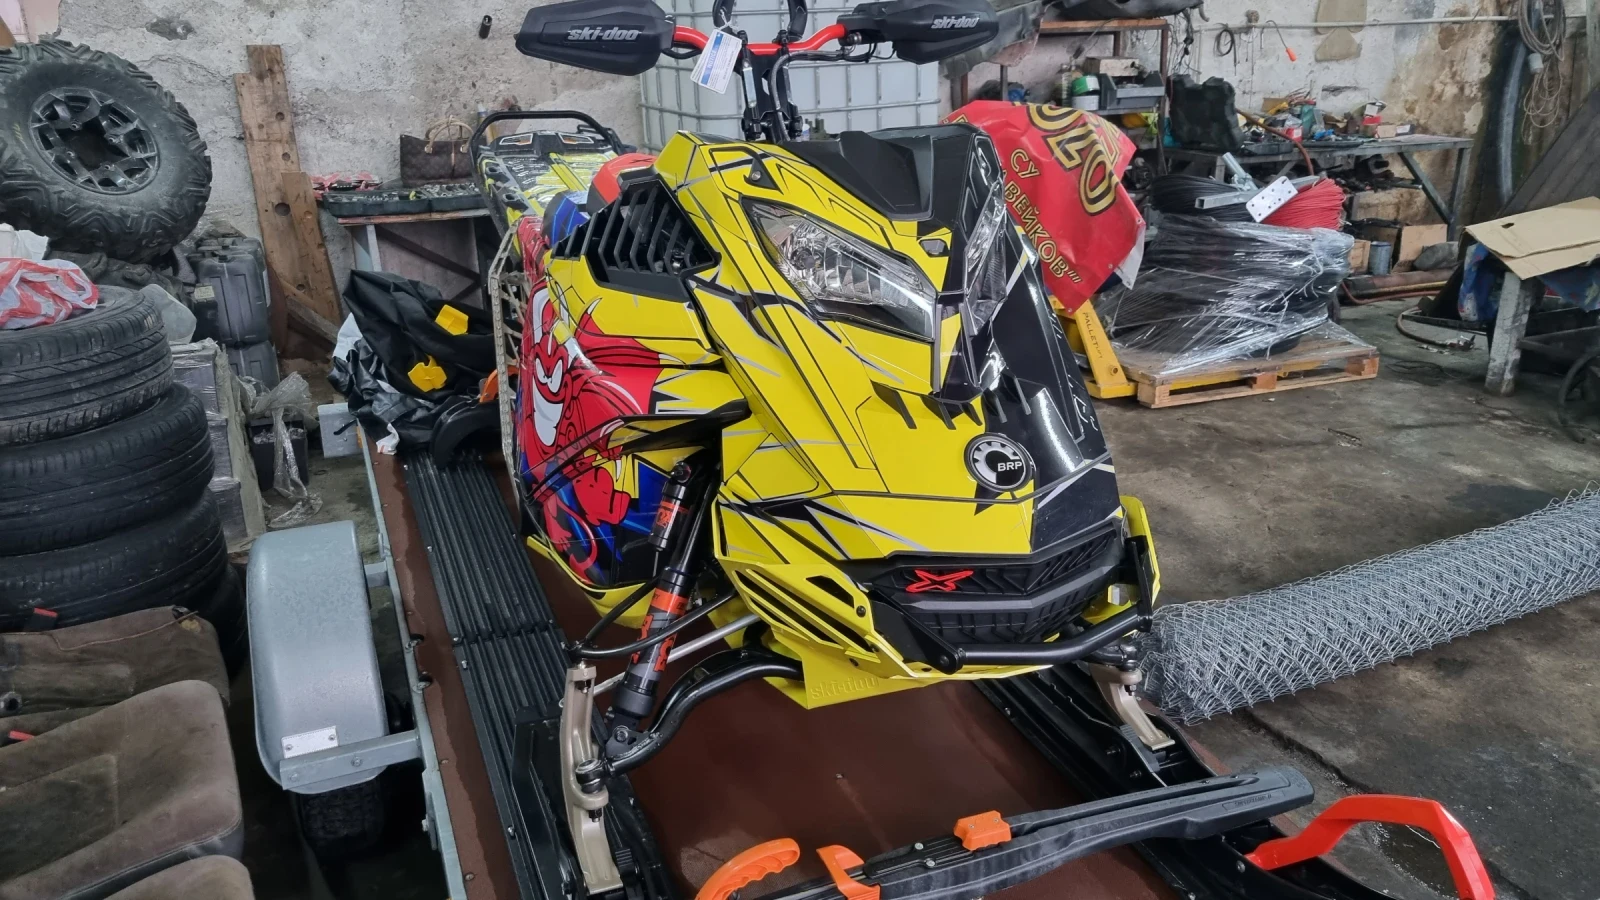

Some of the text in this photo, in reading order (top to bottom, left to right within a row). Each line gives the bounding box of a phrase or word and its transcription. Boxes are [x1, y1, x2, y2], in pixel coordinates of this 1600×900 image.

[931, 16, 980, 29] ski-doo
[567, 27, 639, 41] ski-doo
[997, 461, 1023, 472] BRP
[810, 677, 879, 700] ski-doo
